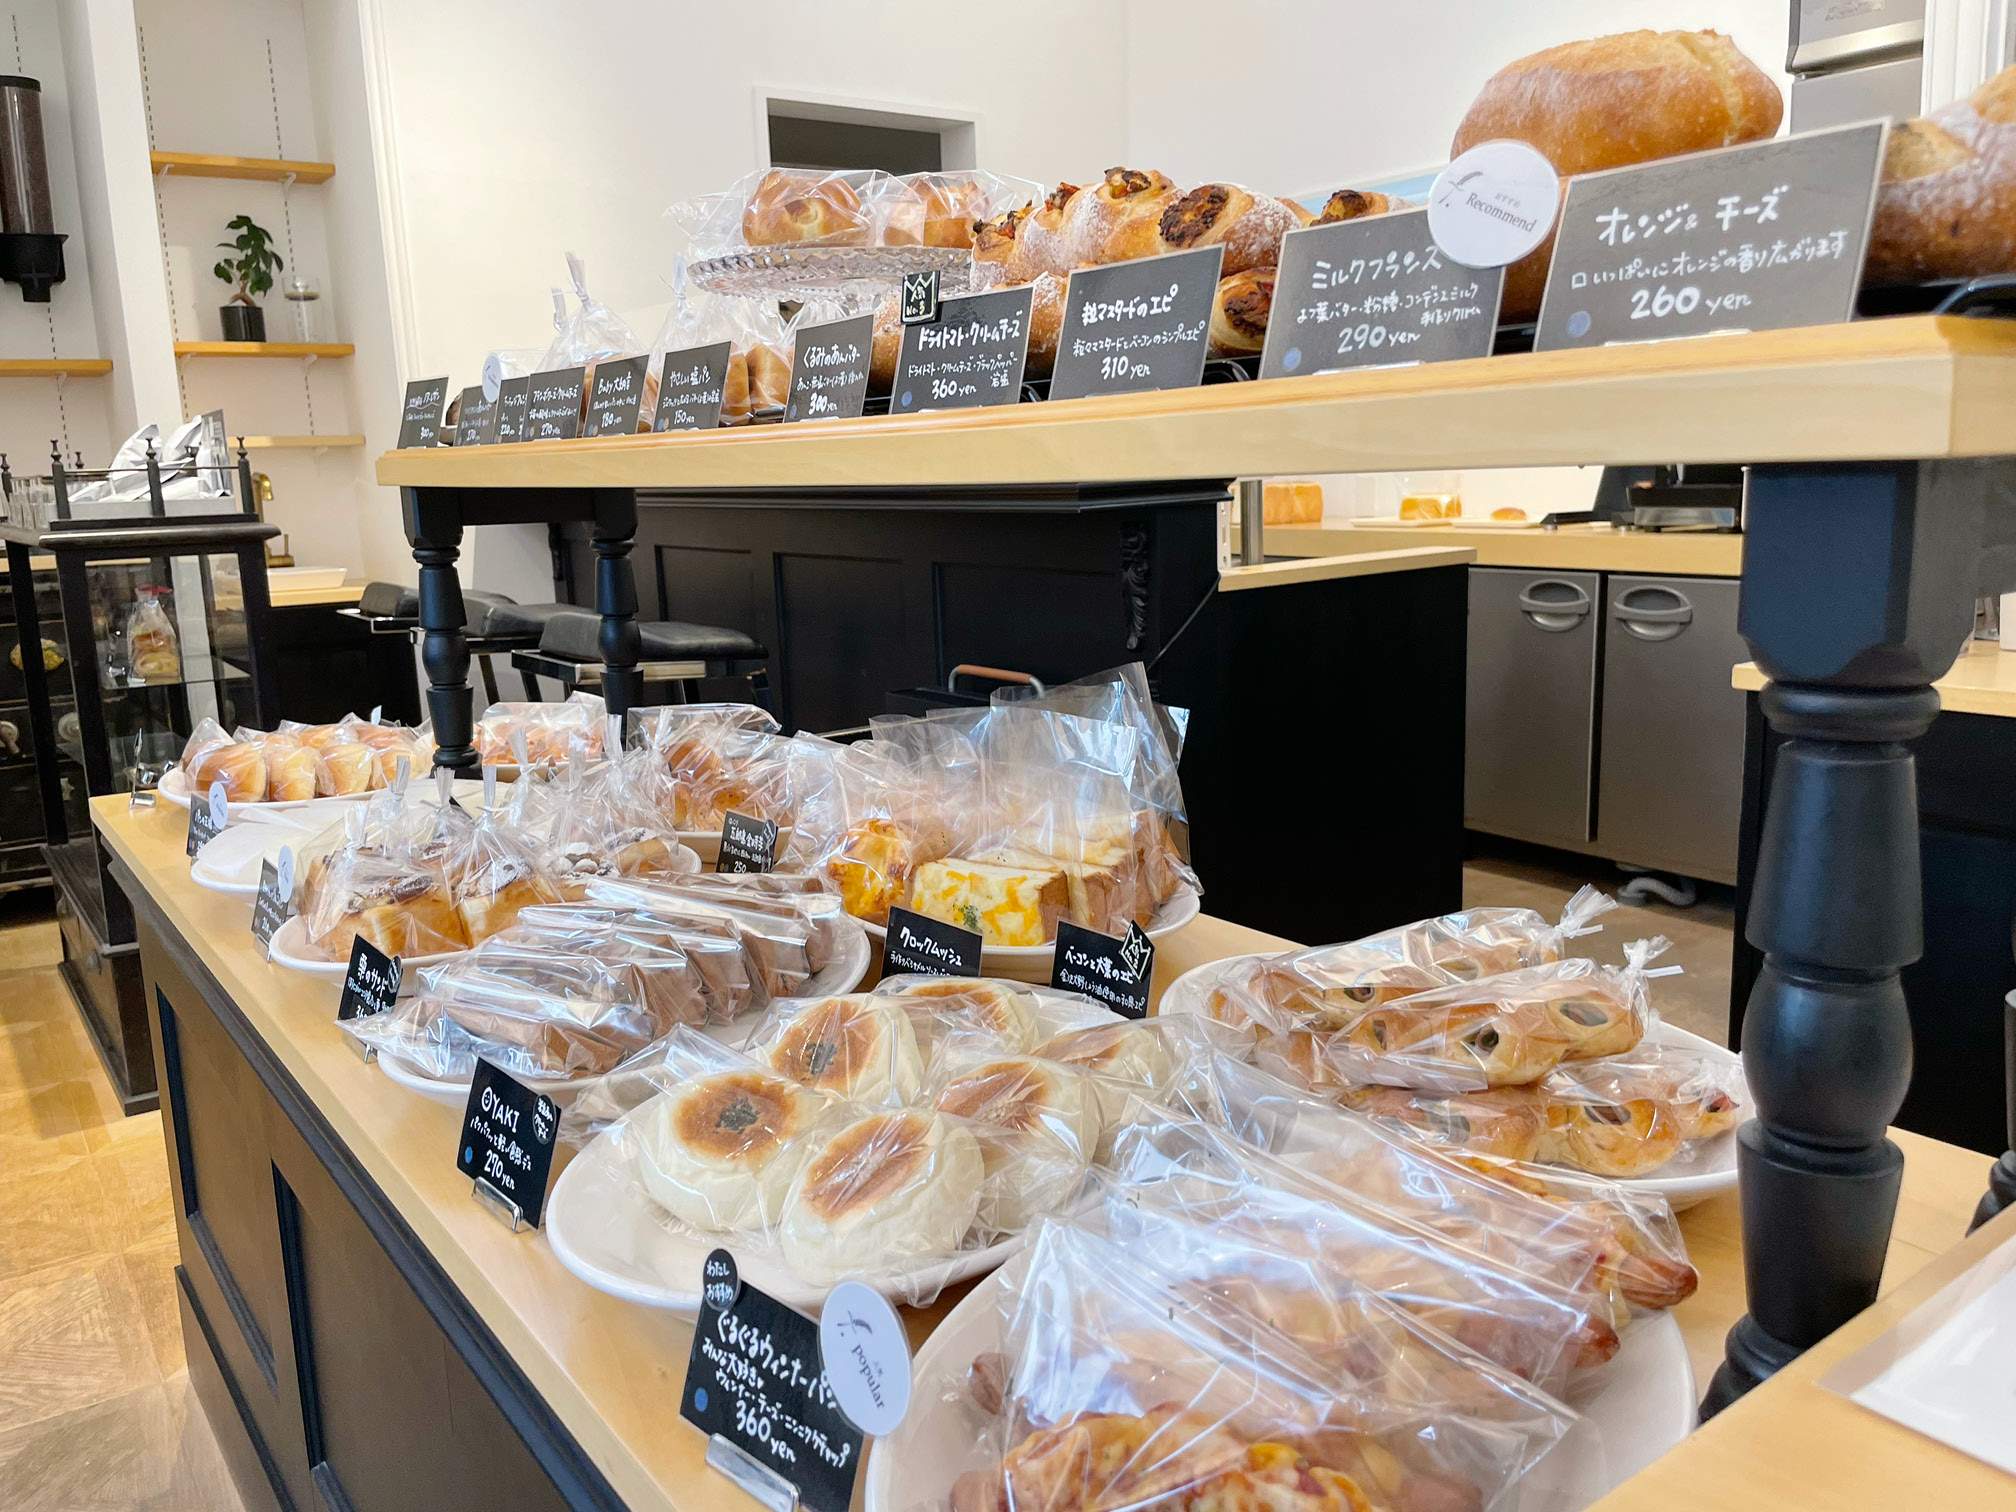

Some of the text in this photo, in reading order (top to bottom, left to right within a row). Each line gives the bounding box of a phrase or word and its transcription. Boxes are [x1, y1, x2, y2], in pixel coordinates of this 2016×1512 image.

[1466, 193, 1537, 232] Recommend
[1630, 285, 1752, 320] 260 yen
[1337, 323, 1421, 354] 290 yen
[1101, 355, 1151, 380] 310 yen
[808, 391, 828, 415] 300
[931, 378, 977, 400] 360 yen
[601, 411, 614, 428] 180
[674, 409, 687, 425] 150
[733, 860, 747, 873] 250
[481, 1086, 520, 1133] OYAKI
[483, 1149, 515, 1190] 270 yen
[706, 1260, 730, 1277] わたし
[851, 1344, 885, 1409] popular
[735, 1400, 796, 1464] 360 yen
